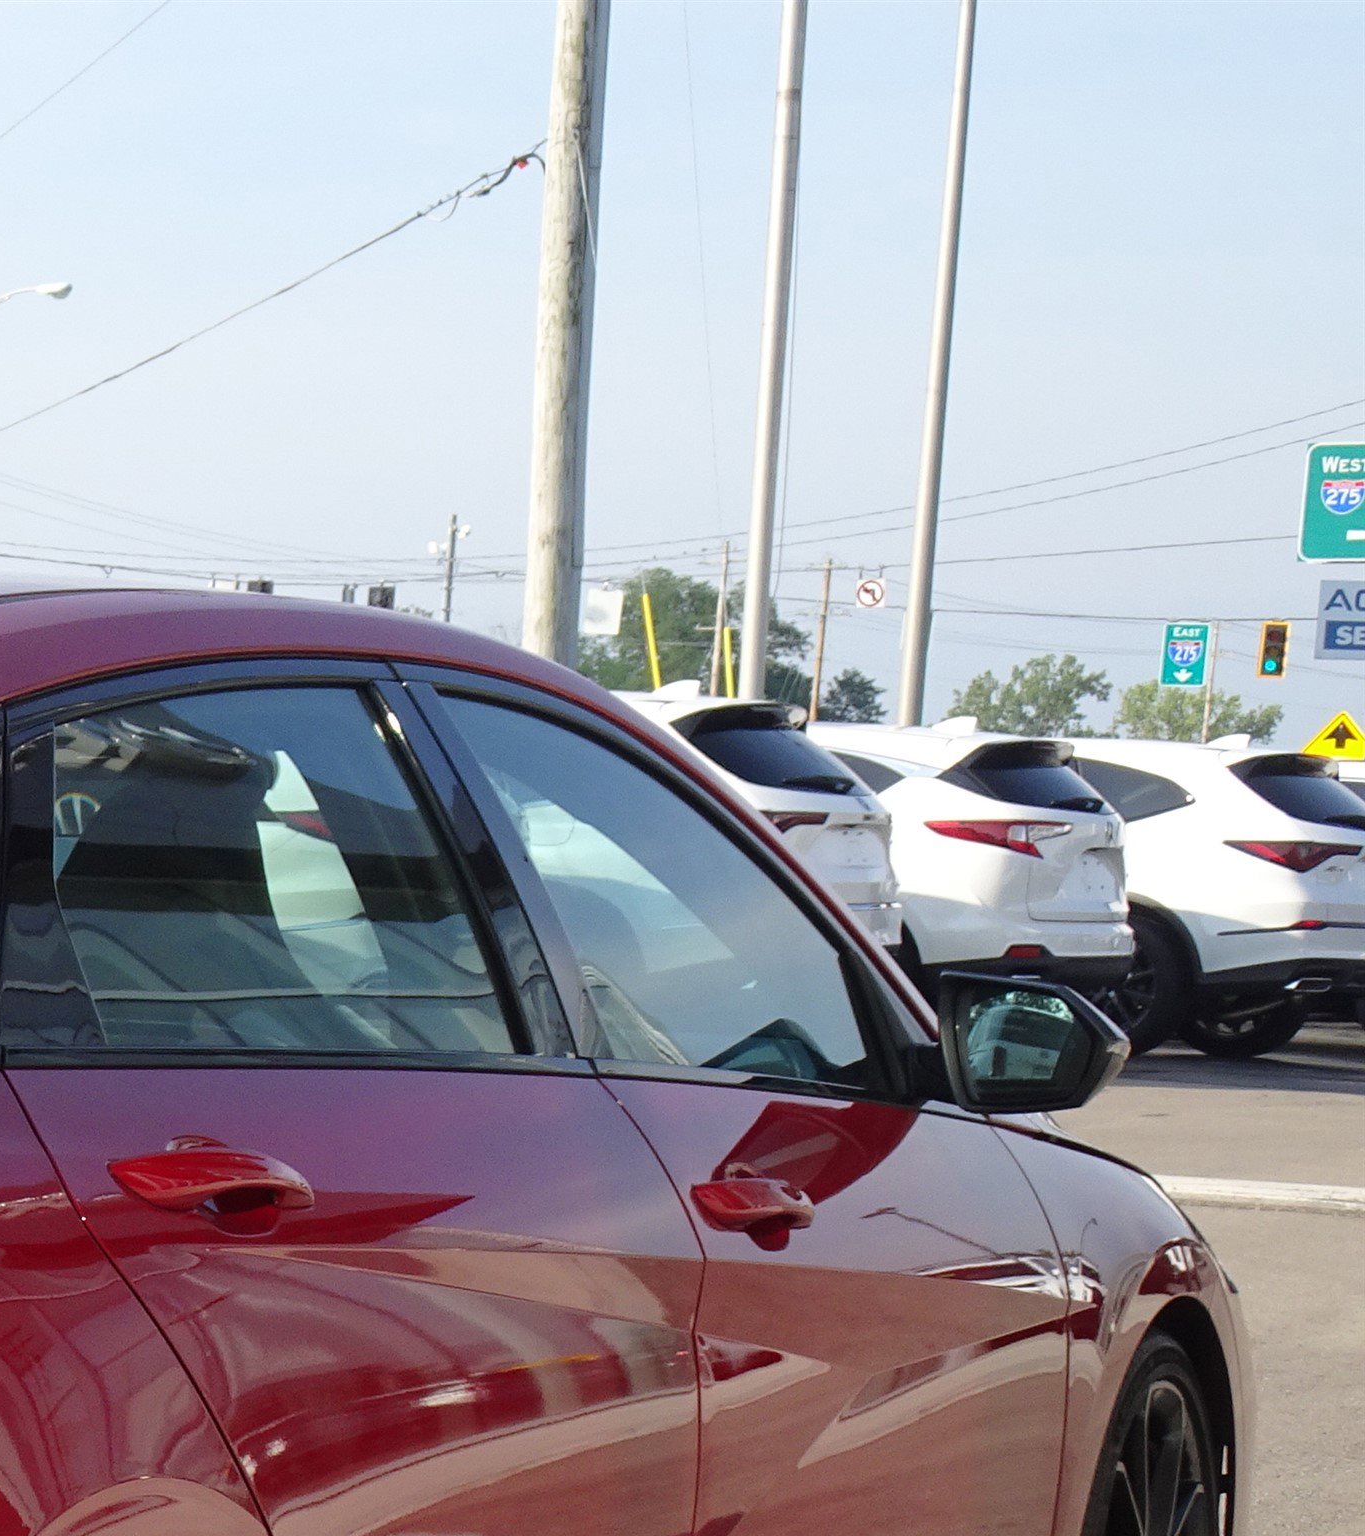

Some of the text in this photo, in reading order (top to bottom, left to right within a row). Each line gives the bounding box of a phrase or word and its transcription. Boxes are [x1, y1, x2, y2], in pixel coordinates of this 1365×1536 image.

[1325, 488, 1361, 504] 275
[1173, 627, 1201, 637] EAST
[1175, 646, 1197, 660] 275
